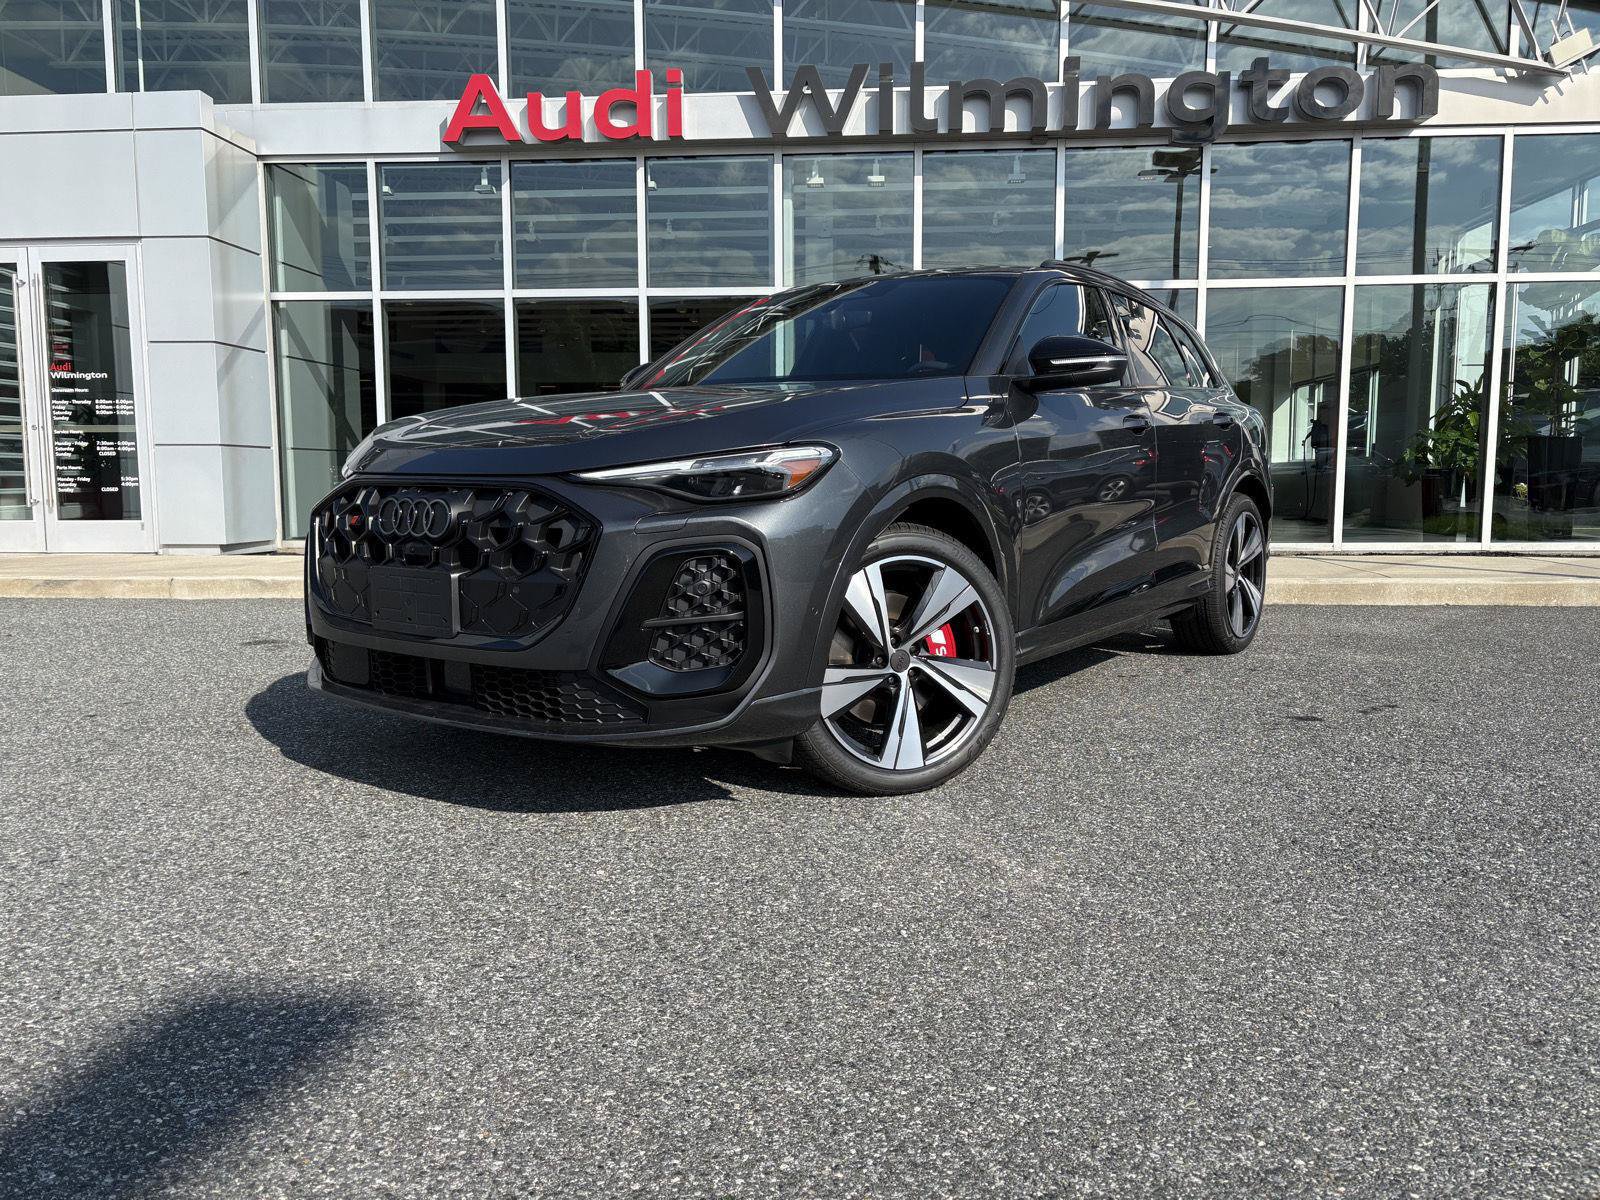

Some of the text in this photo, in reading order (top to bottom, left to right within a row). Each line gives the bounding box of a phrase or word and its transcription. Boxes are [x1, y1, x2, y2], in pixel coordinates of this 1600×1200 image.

[441, 56, 1440, 147] Audi Wilmington
[49, 362, 71, 371] Audi
[50, 371, 108, 380] Wilmington
